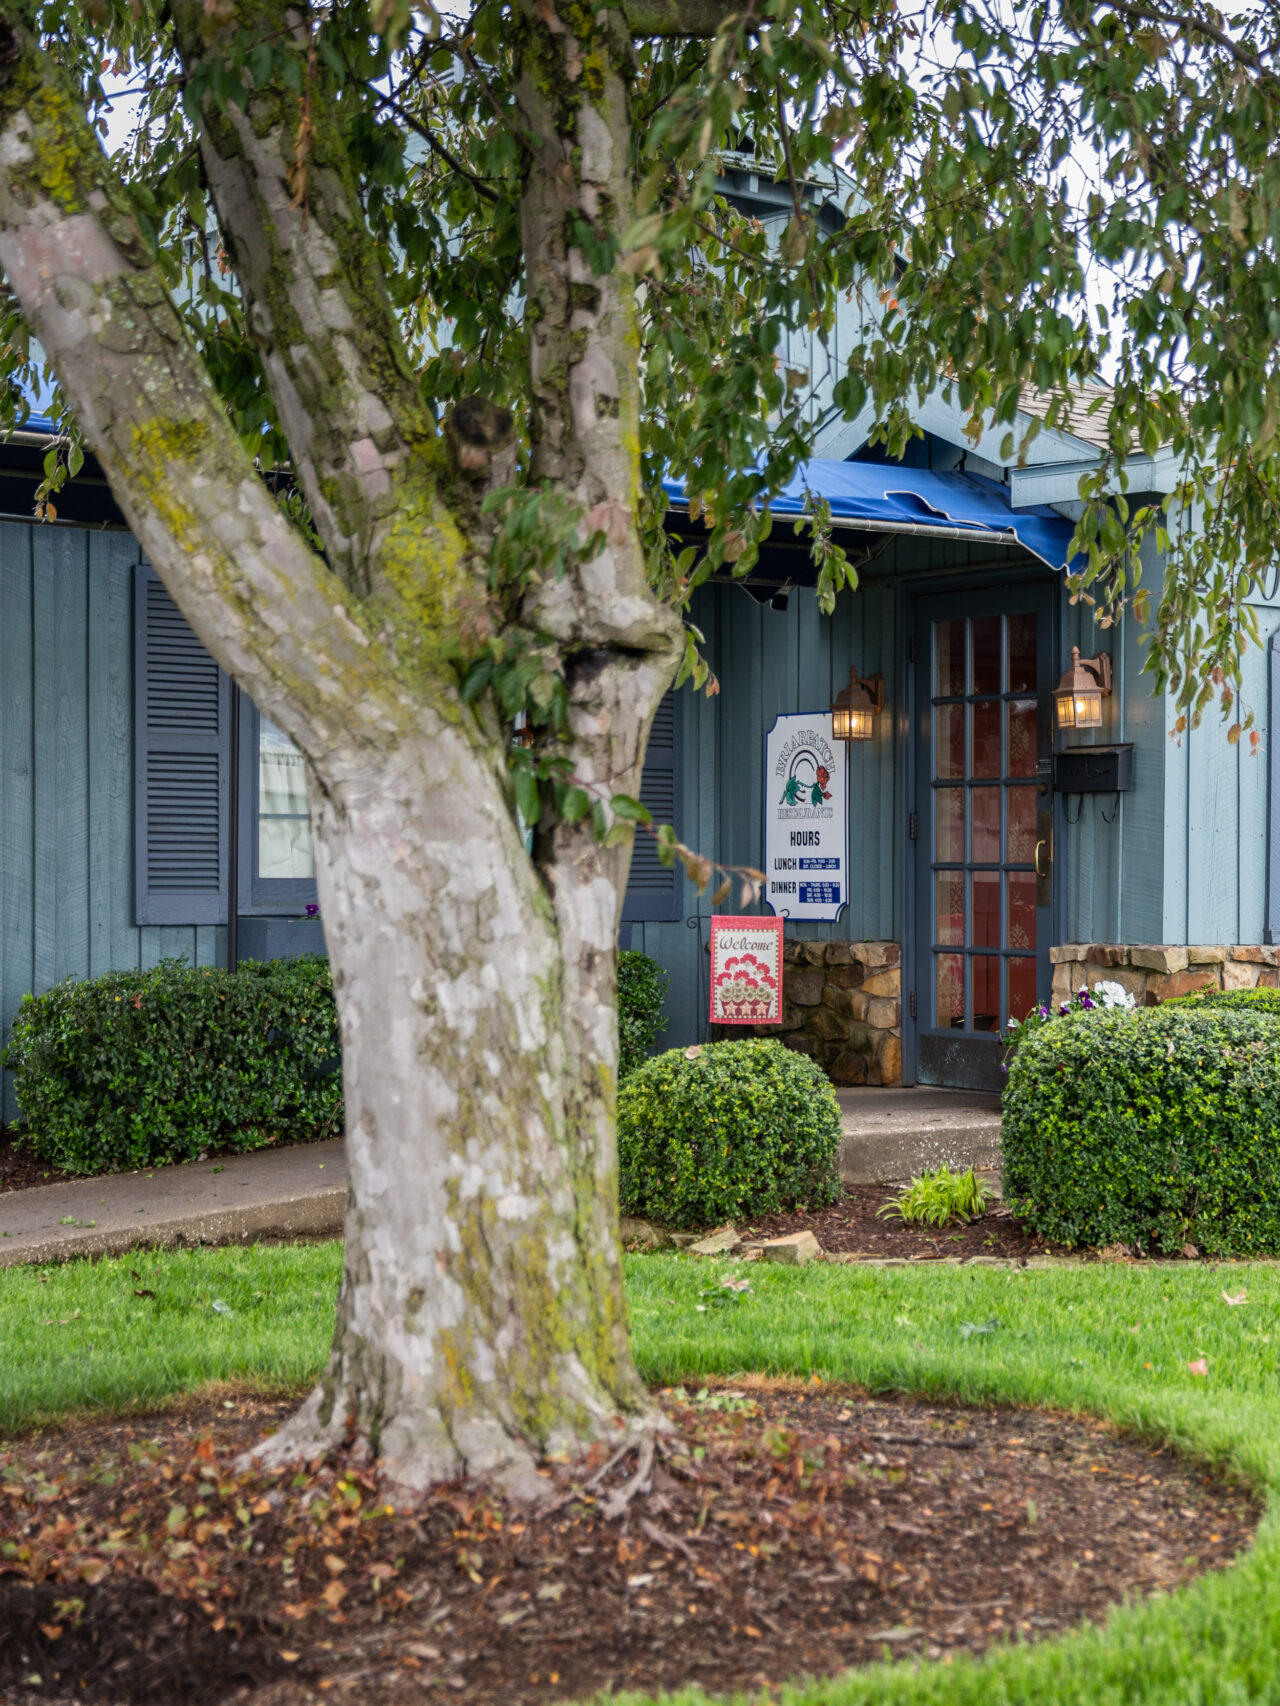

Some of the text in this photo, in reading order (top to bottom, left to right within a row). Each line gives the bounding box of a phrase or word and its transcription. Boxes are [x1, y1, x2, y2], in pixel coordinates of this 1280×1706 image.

[775, 729, 836, 778] BRIARPATCH
[790, 831, 820, 846] HOURS
[774, 858, 797, 870] LUNCH
[771, 881, 797, 894] DINNER
[720, 936, 773, 951] Welcome
